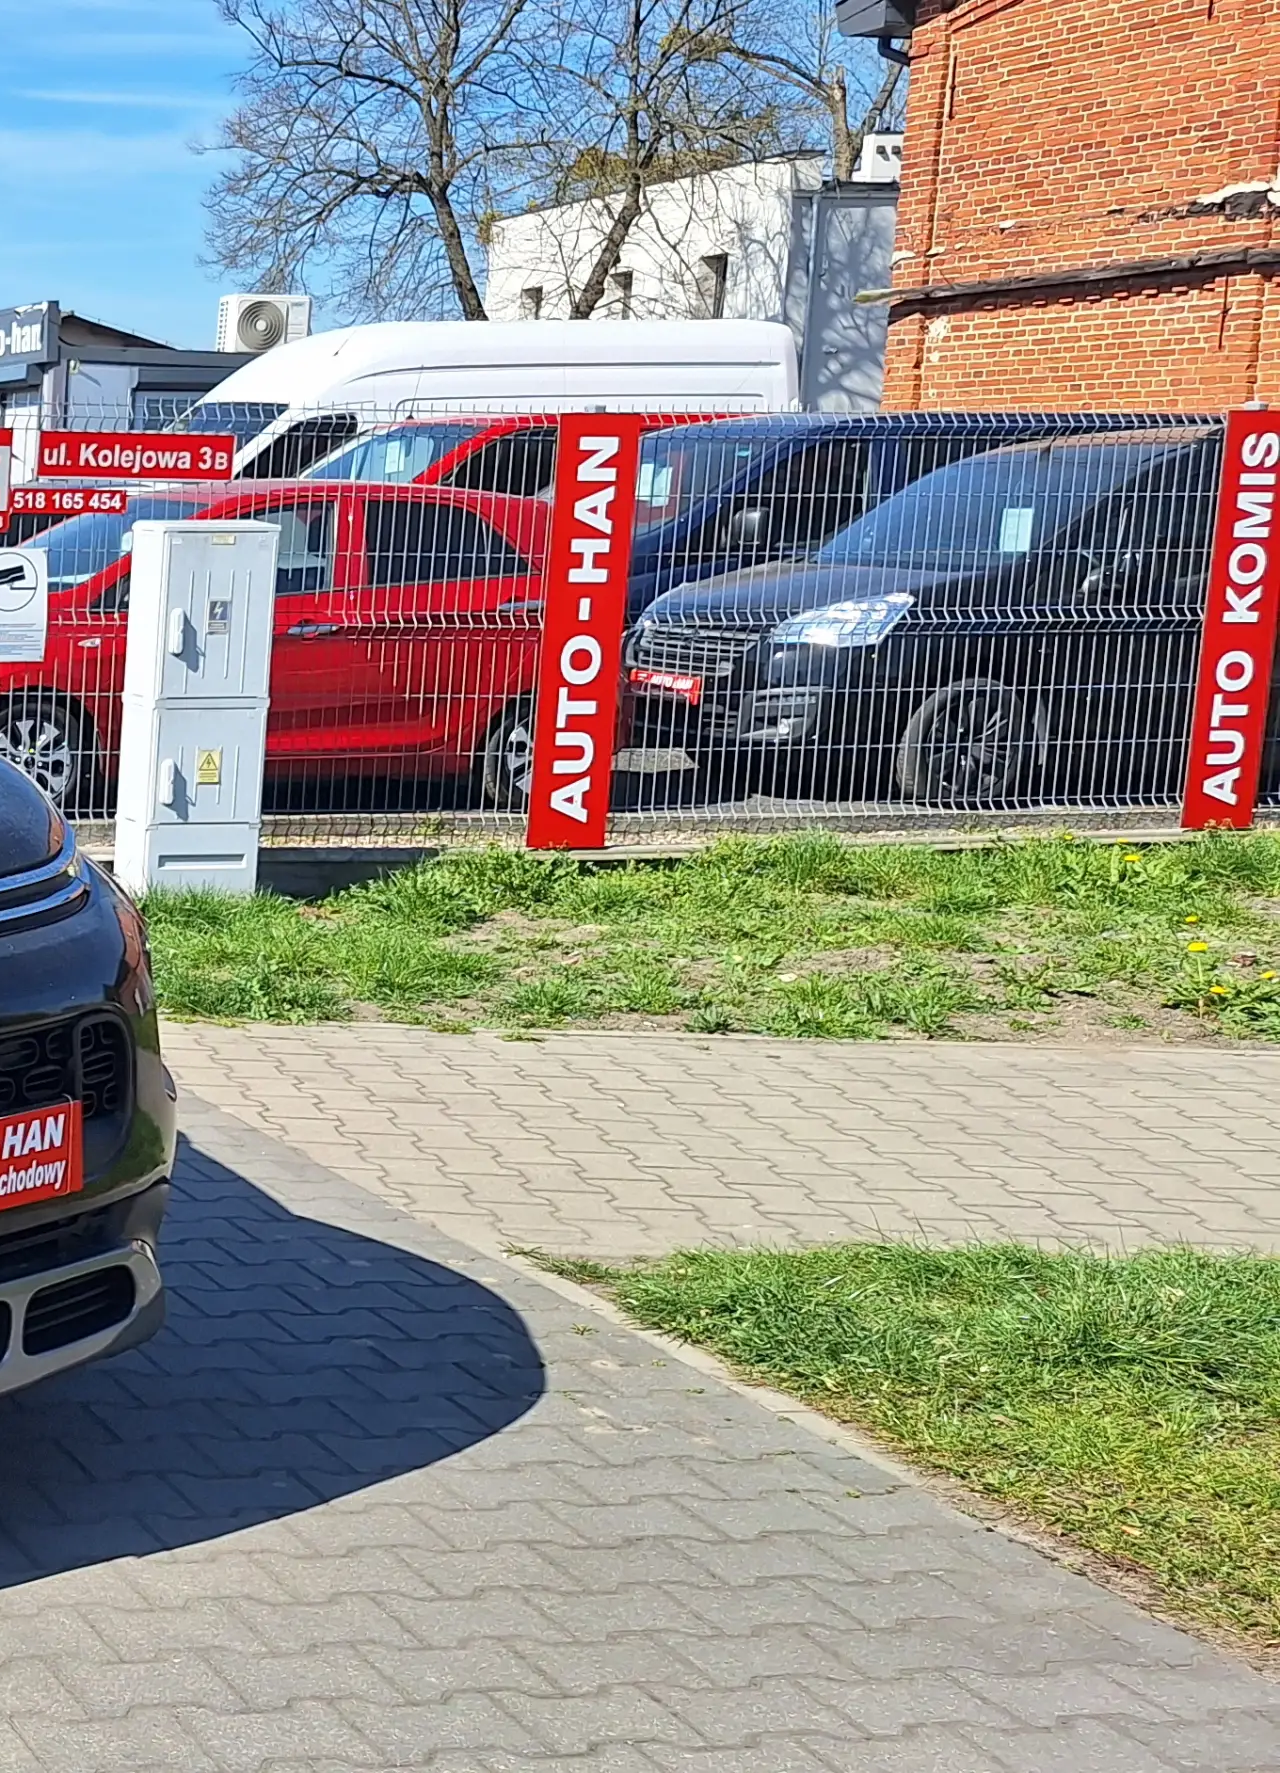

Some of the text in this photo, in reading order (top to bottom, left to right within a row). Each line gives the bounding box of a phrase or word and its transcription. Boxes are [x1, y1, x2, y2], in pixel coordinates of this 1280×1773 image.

[42, 442, 228, 474] ul. Kolejowa 3B
[13, 492, 122, 509] 518 165 454
[550, 436, 621, 823] AUTO-HAN
[1202, 431, 1280, 806] AUTO KOMIS
[1, 1113, 66, 1160] HAN
